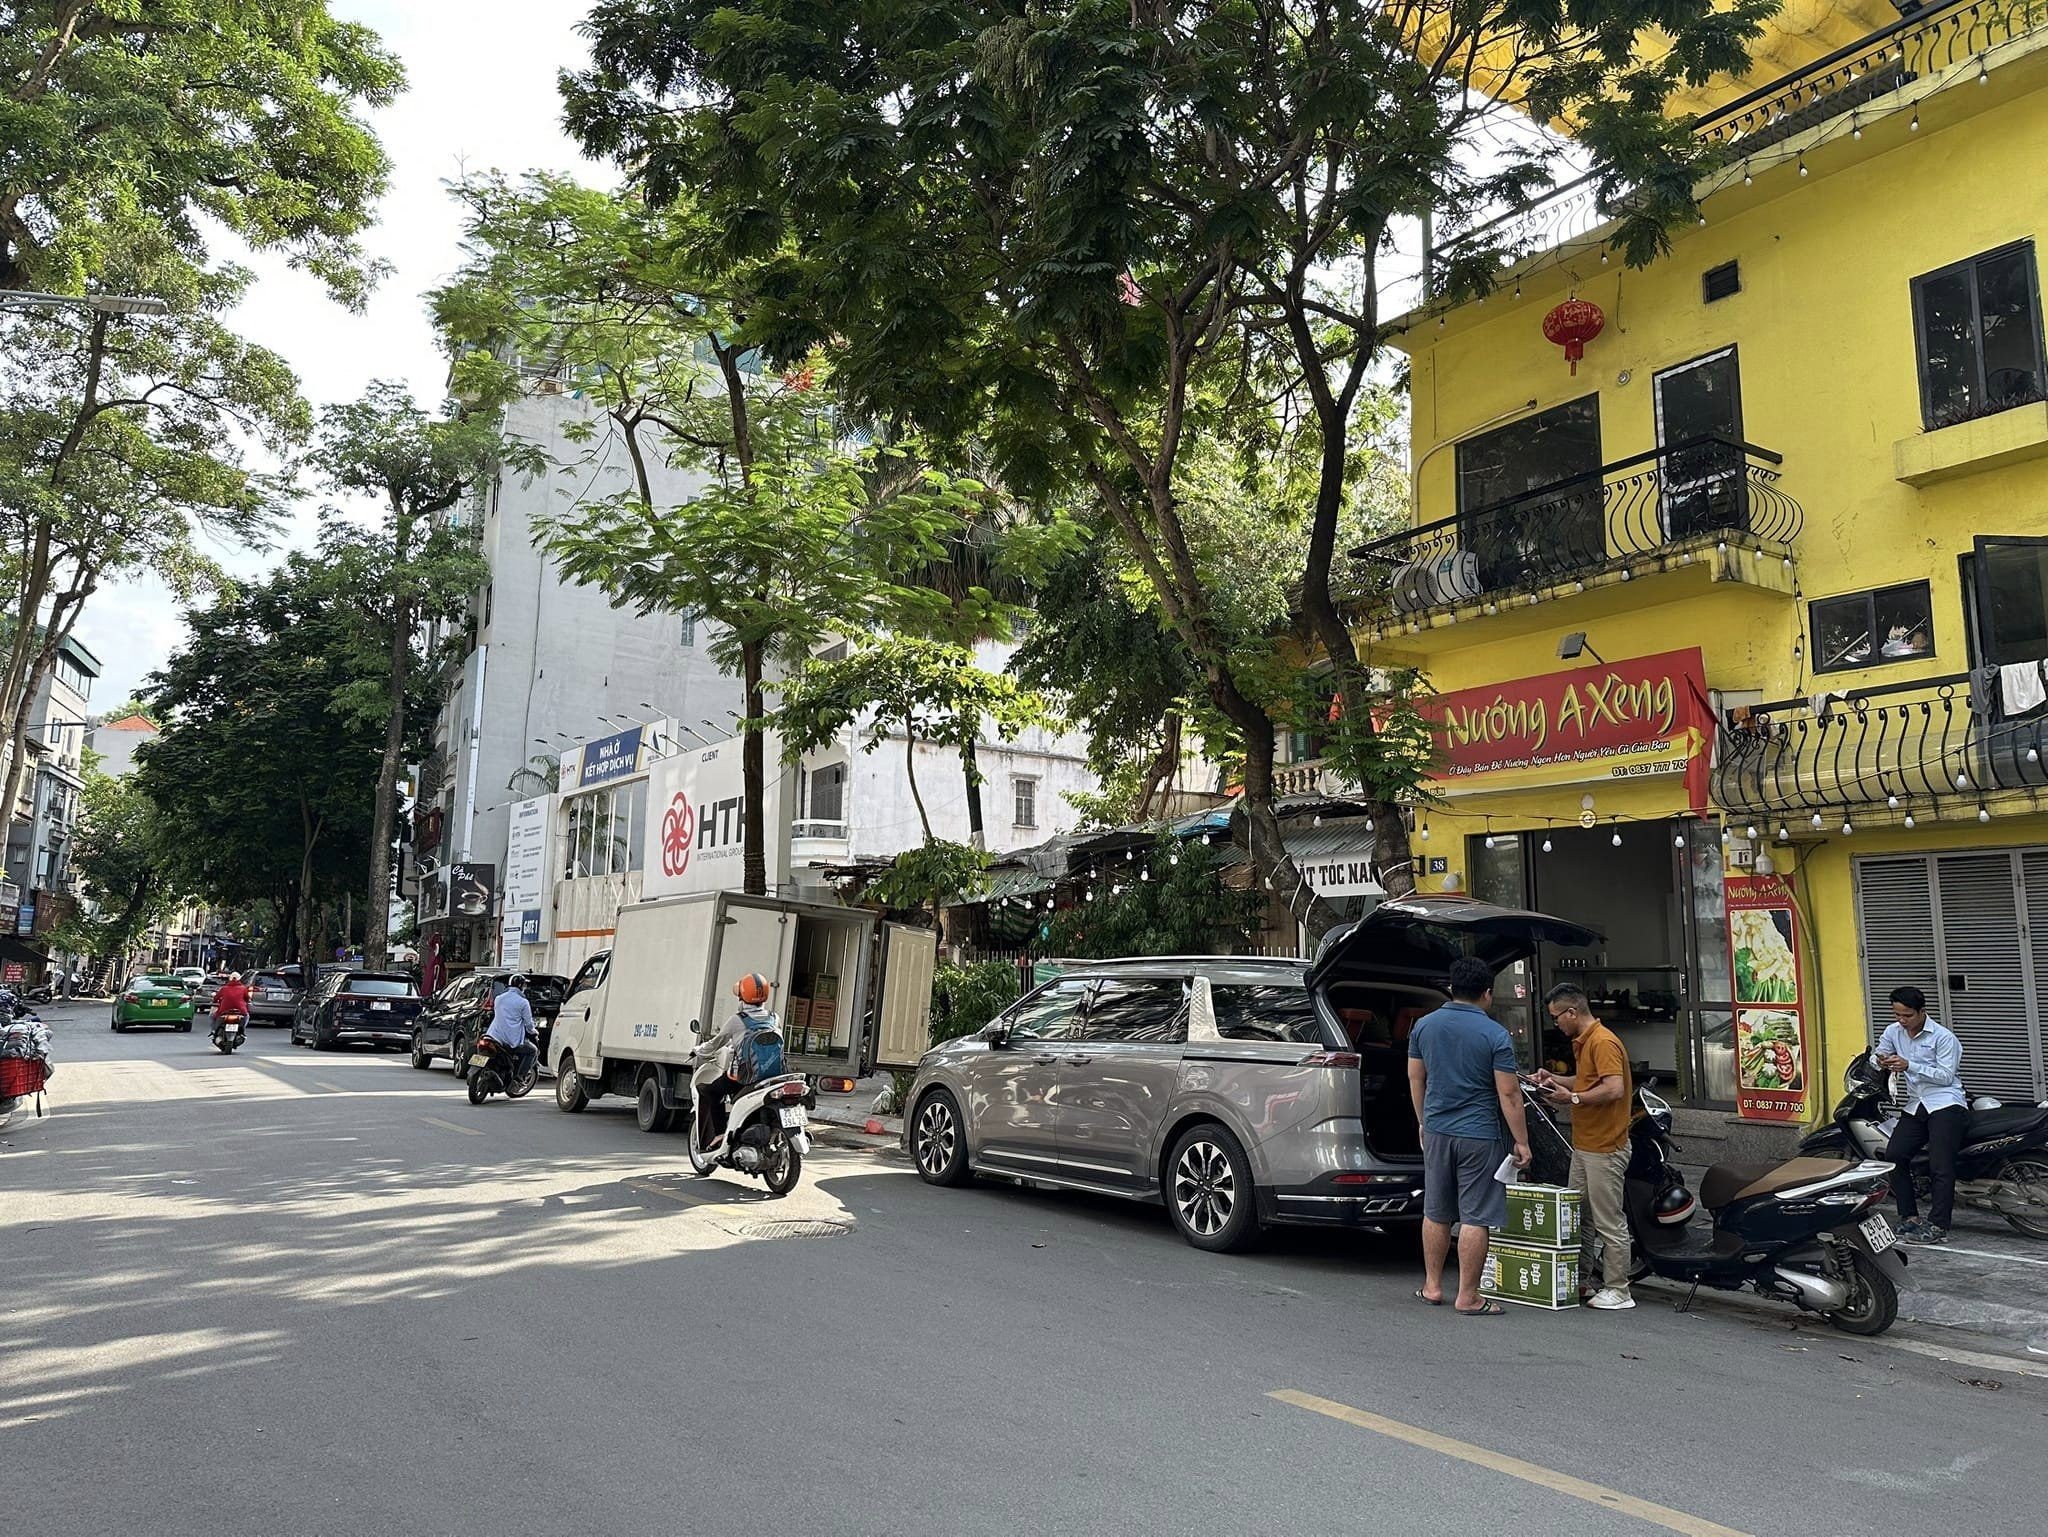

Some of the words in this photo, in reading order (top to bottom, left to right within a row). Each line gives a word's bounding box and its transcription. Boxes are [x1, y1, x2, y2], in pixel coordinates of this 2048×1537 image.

[1445, 694, 1549, 752] Nướng
[600, 742, 613, 759] NHÀ
[702, 749, 719, 762] CLIENT
[610, 755, 625, 773] DỊCH
[625, 752, 634, 769] VỤ
[1456, 765, 1472, 777] Đây
[1474, 763, 1489, 773] Bán
[1531, 755, 1552, 767] Ngon
[1553, 752, 1571, 762] Hơn
[1600, 746, 1615, 757] Yêu
[1617, 744, 1629, 755] Cũ
[1631, 742, 1649, 753] Của
[1651, 740, 1670, 752] Bạn
[1629, 763, 1651, 775] 0837
[1653, 761, 1670, 772] 777
[452, 865, 464, 875] Cà
[1319, 858, 1345, 886] TÓC
[1432, 859, 1445, 871] 38
[523, 920, 535, 934] GATE
[1756, 1100, 1773, 1110] 0837
[1775, 1101, 1788, 1111] 777
[1789, 1102, 1805, 1112] 700
